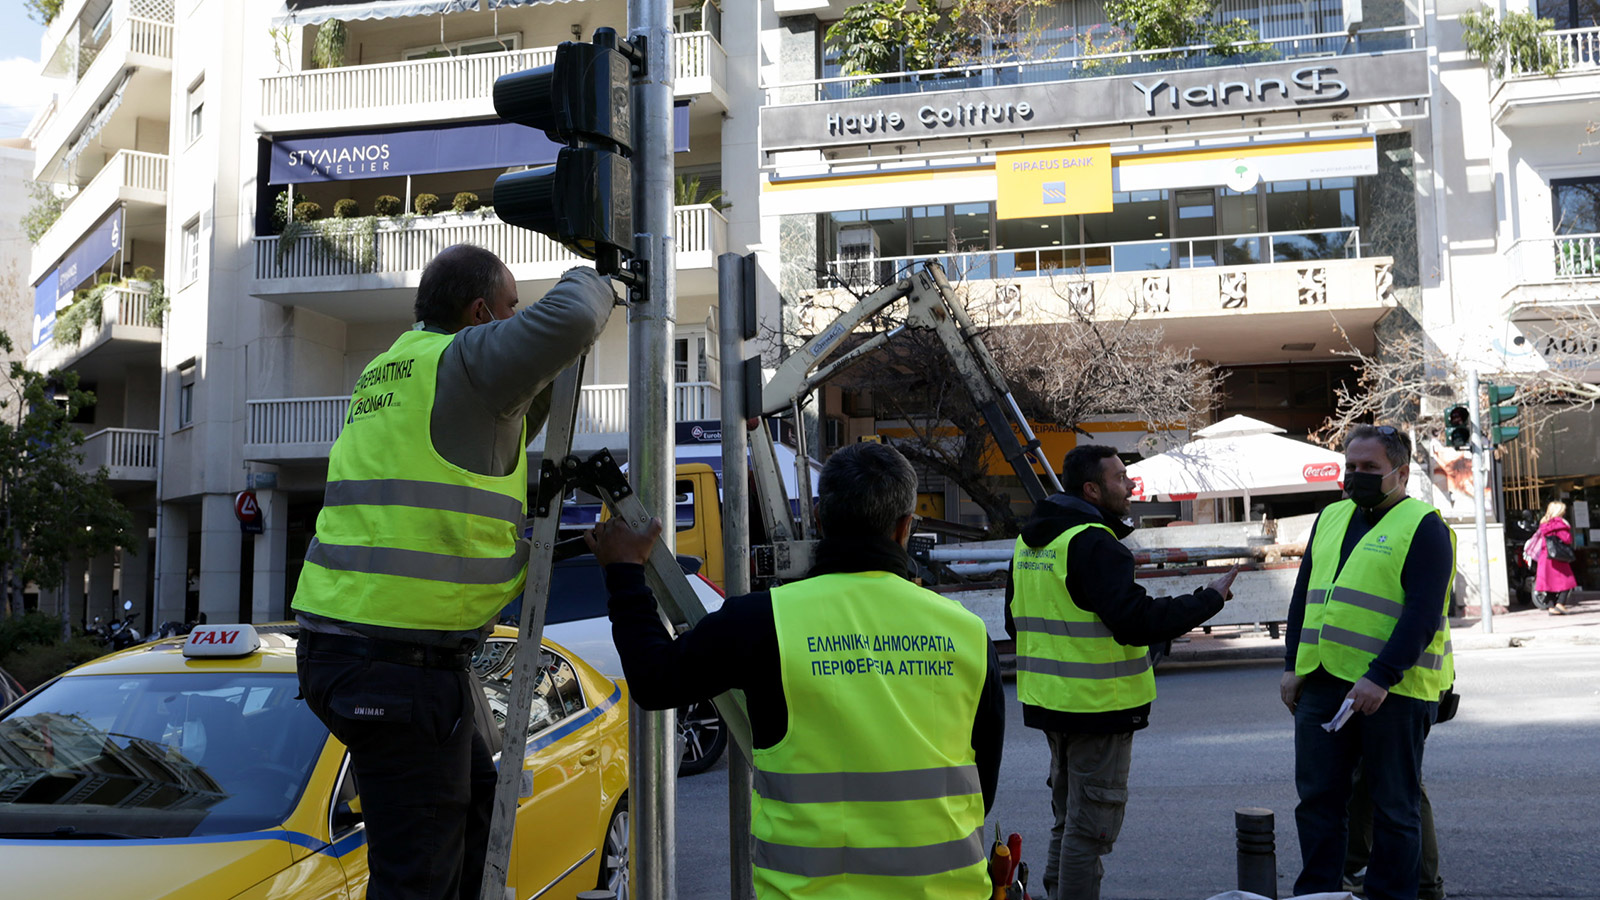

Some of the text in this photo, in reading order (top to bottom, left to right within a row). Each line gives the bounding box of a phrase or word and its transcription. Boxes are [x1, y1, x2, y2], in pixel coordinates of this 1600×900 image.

[826, 101, 1032, 132] Haute Coiffure
[311, 161, 390, 176] ATELIER
[1012, 157, 1094, 172] PIRAEUS BANK
[191, 630, 240, 645] TAXI
[807, 633, 956, 652] ΕΛΛΗΝΙΚΗ ΔΗΜΟΚΡΑΤΙΑ
[811, 657, 954, 676] ΠΕΡΙΦΕΡΕΙΑ ΑΤΤΙΚΗΣ
[354, 707, 385, 716] UNIMAC
